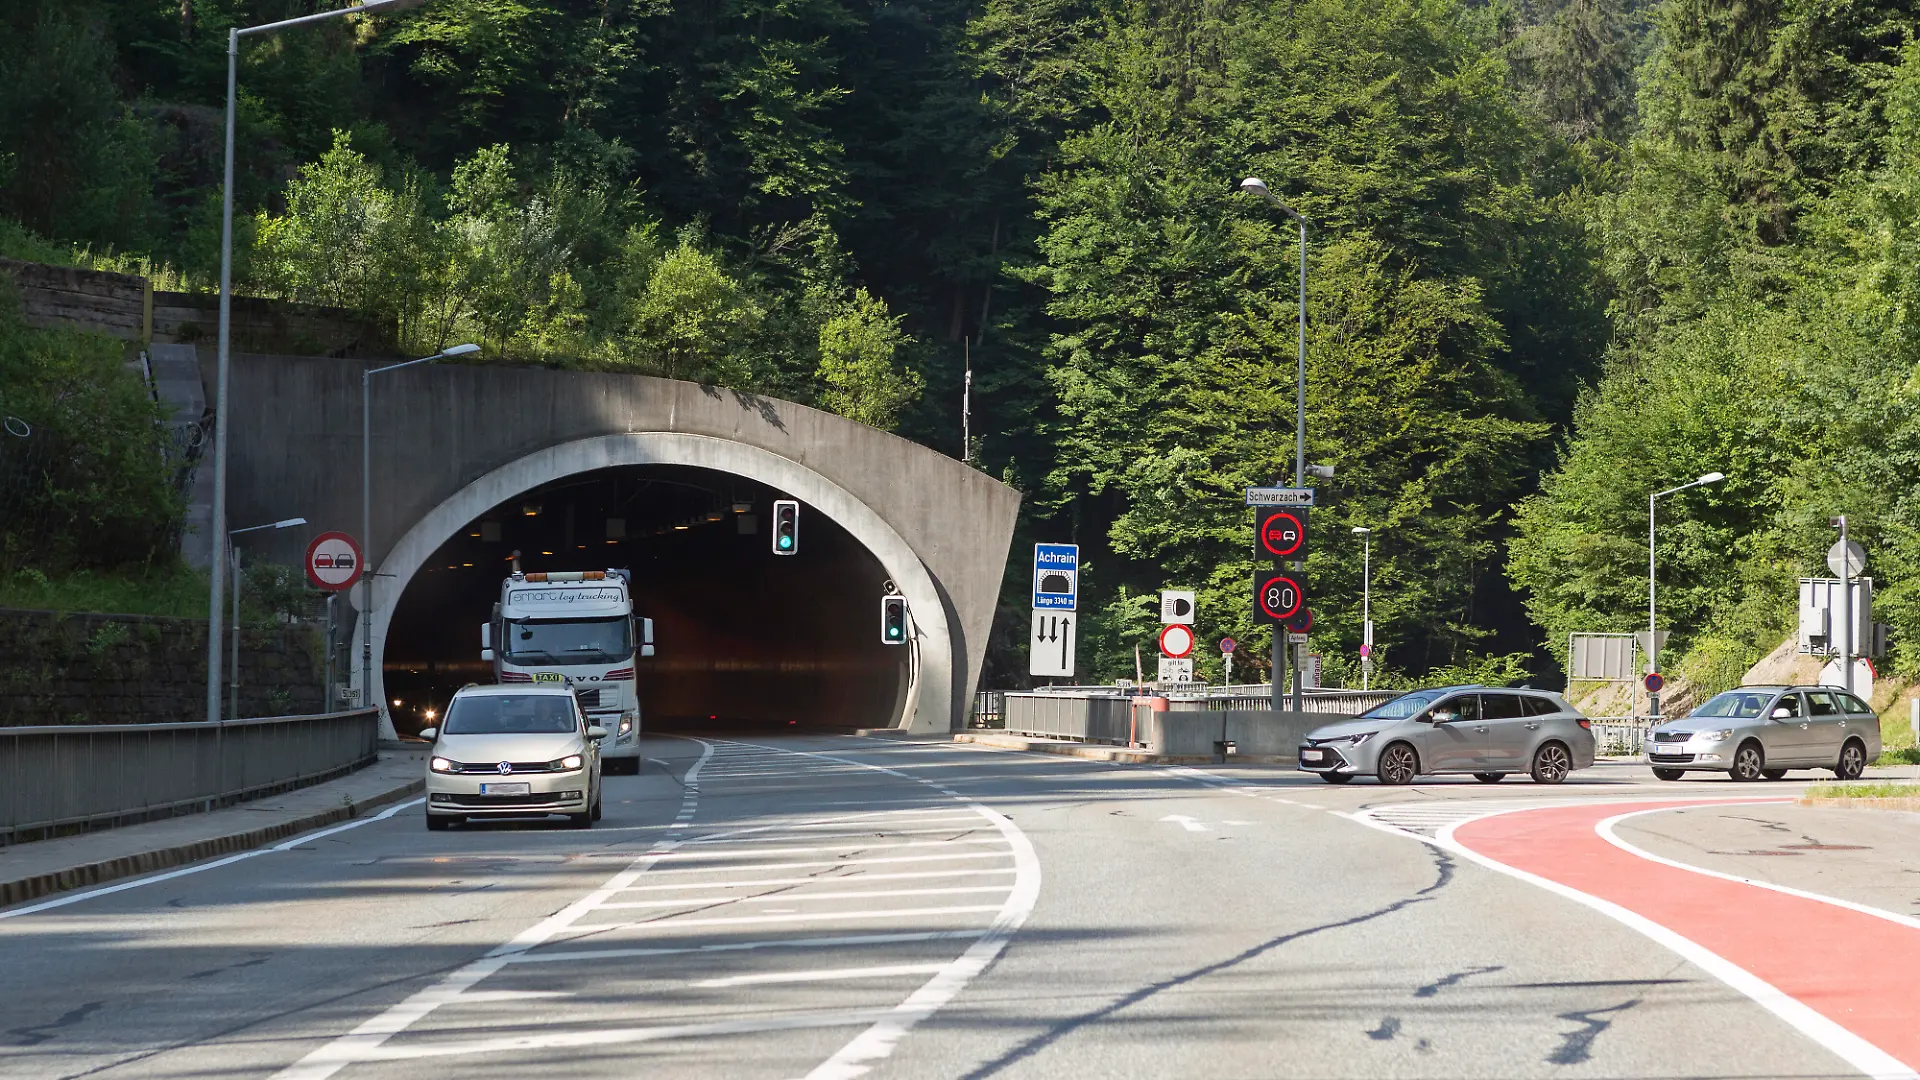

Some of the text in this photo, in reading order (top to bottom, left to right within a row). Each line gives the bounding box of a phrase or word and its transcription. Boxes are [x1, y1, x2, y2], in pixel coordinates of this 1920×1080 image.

[1249, 491, 1298, 502] Schwarzach
[1037, 551, 1075, 564] Achrain
[513, 592, 557, 602] erhart
[1037, 596, 1053, 605] Länge
[1054, 597, 1068, 605] 3340
[1268, 588, 1293, 608] 80
